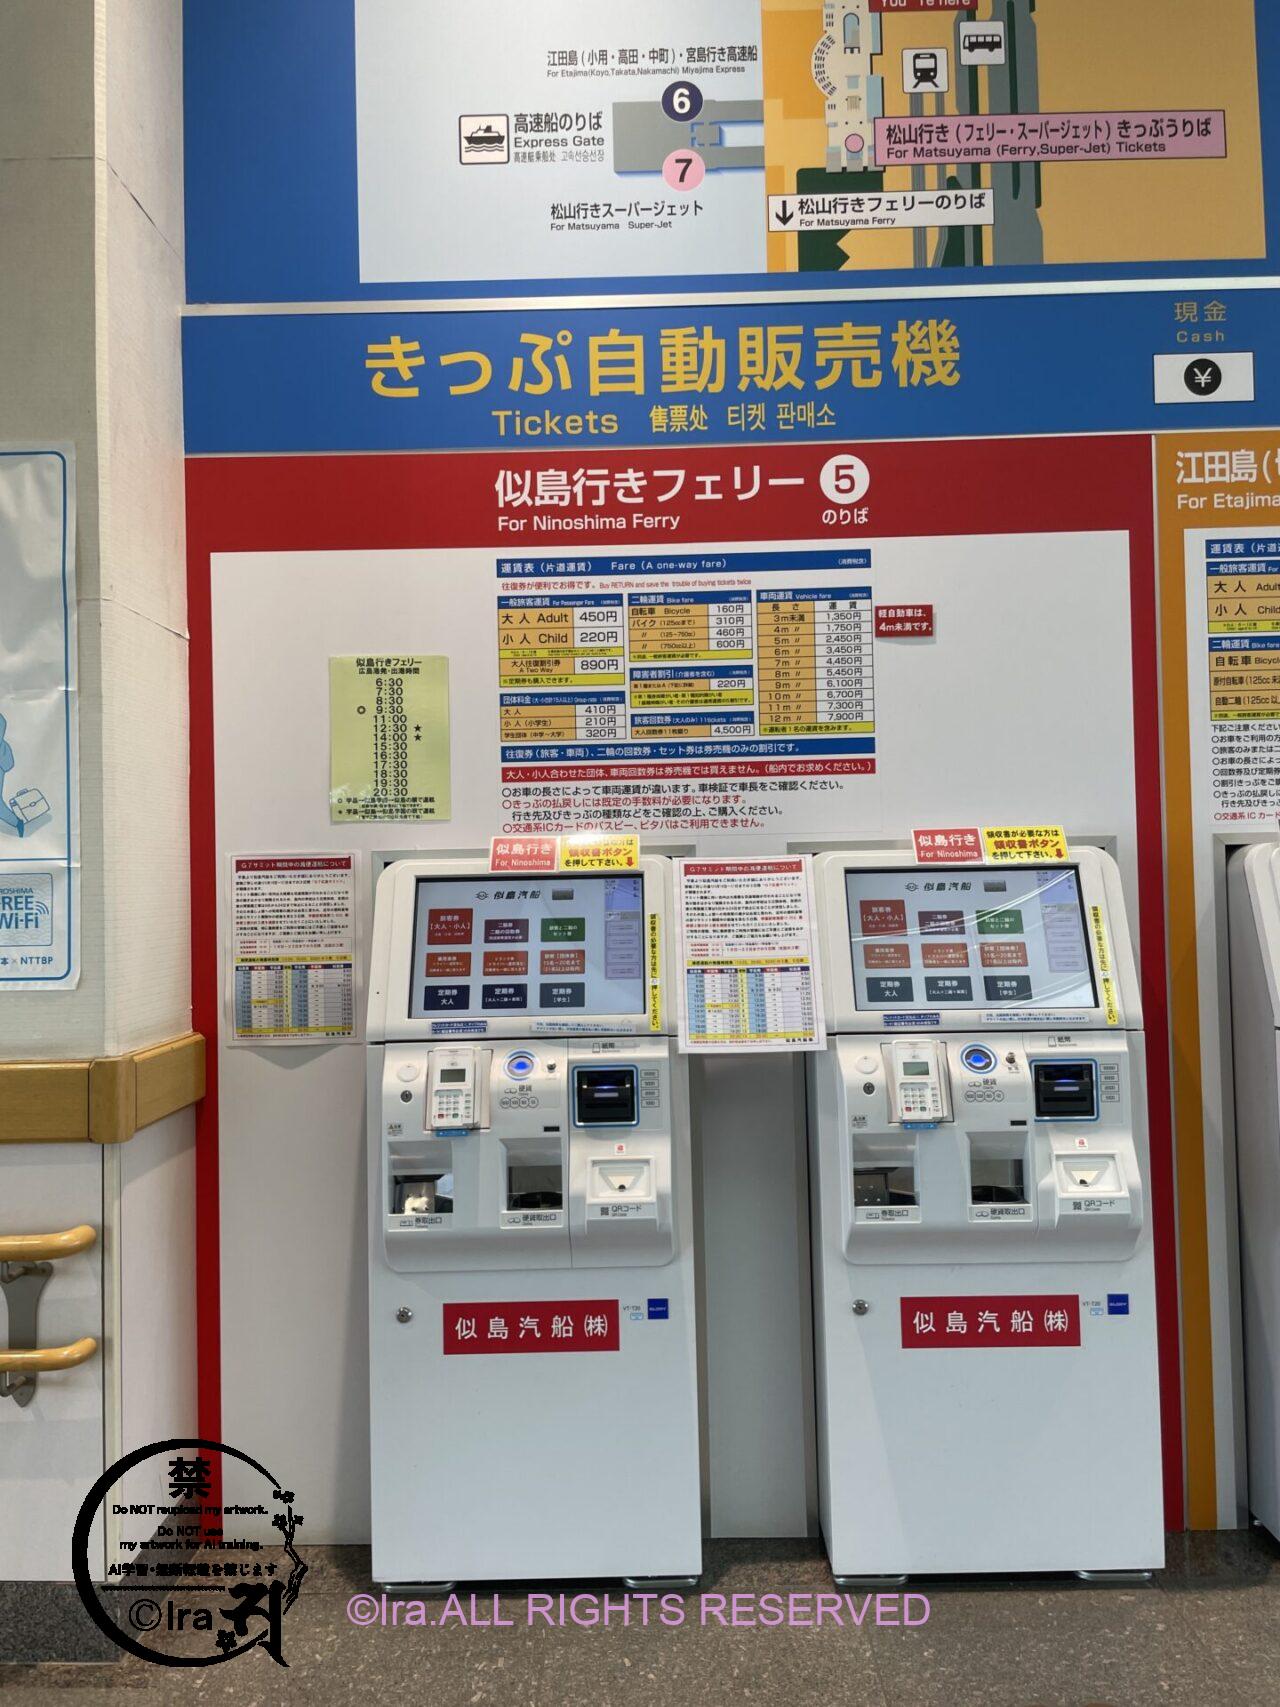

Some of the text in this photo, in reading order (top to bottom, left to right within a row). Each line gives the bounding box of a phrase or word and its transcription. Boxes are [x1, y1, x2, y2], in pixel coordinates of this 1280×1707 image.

[547, 69, 559, 78] For
[682, 66, 713, 75] Miyajima
[715, 65, 745, 75] Express
[673, 88, 690, 113] 6
[514, 111, 603, 133] 高速船のりば
[514, 135, 605, 149] Express Gate
[886, 140, 1167, 160] For Matsuyama (Ferry,Super-Jet) Tickets
[674, 158, 692, 183] 7
[798, 193, 986, 215] 松山行きフェリーのりば
[551, 200, 704, 220] 松山行きスーパージェット
[551, 220, 673, 233] For Matsuyama Super-Jet
[800, 216, 896, 229] For Matsuyama Ferry
[1174, 300, 1227, 323] 現金
[1176, 330, 1225, 343] Cash
[366, 318, 962, 398] きっぷ自動販売機
[492, 408, 619, 436] Tickets
[727, 401, 768, 431] 티켓
[776, 400, 837, 431] 판매소
[1176, 449, 1280, 485] 江田島（
[494, 464, 857, 508] 似島行きフェリー 5
[1177, 494, 1207, 510] For
[498, 511, 681, 532] For Ninoshima Ferry
[821, 508, 869, 526] のりば
[501, 561, 592, 574] 運賃表（片道運賃）
[611, 561, 636, 571] Fare
[657, 560, 698, 571] one-way
[631, 604, 744, 616] 自転車 Bicycle 160円
[537, 612, 569, 623] Adult
[579, 611, 618, 623] 450円
[716, 615, 744, 625] 310円
[827, 612, 862, 622] 1,350円
[716, 627, 744, 637] 460円
[827, 623, 862, 633] 1,750円
[538, 633, 568, 645] Child
[580, 631, 618, 643] 220円
[826, 634, 862, 644] 2,450円
[716, 639, 744, 649] 600円
[826, 645, 862, 655] 3,450円
[356, 658, 422, 668] 似島行きフェリー
[580, 659, 619, 671] 890円
[826, 656, 862, 666] 4,450円
[1215, 655, 1252, 667] 自転車
[827, 667, 862, 677] 5,450円
[376, 678, 403, 687] 6:30
[717, 679, 746, 689] 220円
[827, 679, 863, 688] 6,100円
[375, 687, 403, 696] 7:30
[827, 690, 863, 699] 6,700円
[376, 696, 403, 705] 8:30
[828, 701, 863, 710] 7,300円
[376, 705, 403, 714] 9:30
[585, 704, 617, 714] 410円
[373, 715, 407, 724] 11:00
[585, 716, 617, 726] 210円
[828, 712, 864, 721] 7,900円
[373, 724, 407, 733] 12:30
[585, 728, 617, 738] 320円
[714, 725, 751, 735] 4,500円
[373, 733, 407, 742] 14:00
[373, 742, 407, 751] 15:30
[373, 751, 407, 760] 16:30
[373, 760, 408, 769] 17:30
[373, 769, 408, 779] 18:30
[373, 779, 408, 788] 19:30
[373, 788, 408, 797] 20:30
[917, 833, 977, 847] 似島行き
[993, 838, 1060, 849] 領収書ボタン
[496, 843, 552, 855] 似島行き
[920, 849, 979, 859] For Ninoshima
[495, 858, 551, 867] For Ninoshima
[923, 881, 972, 891] 似島汽船
[493, 890, 542, 900] 似島汽船
[0, 895, 34, 911] REE
[611, 1204, 642, 1213] QRコード
[1083, 1200, 1115, 1208] QRコード
